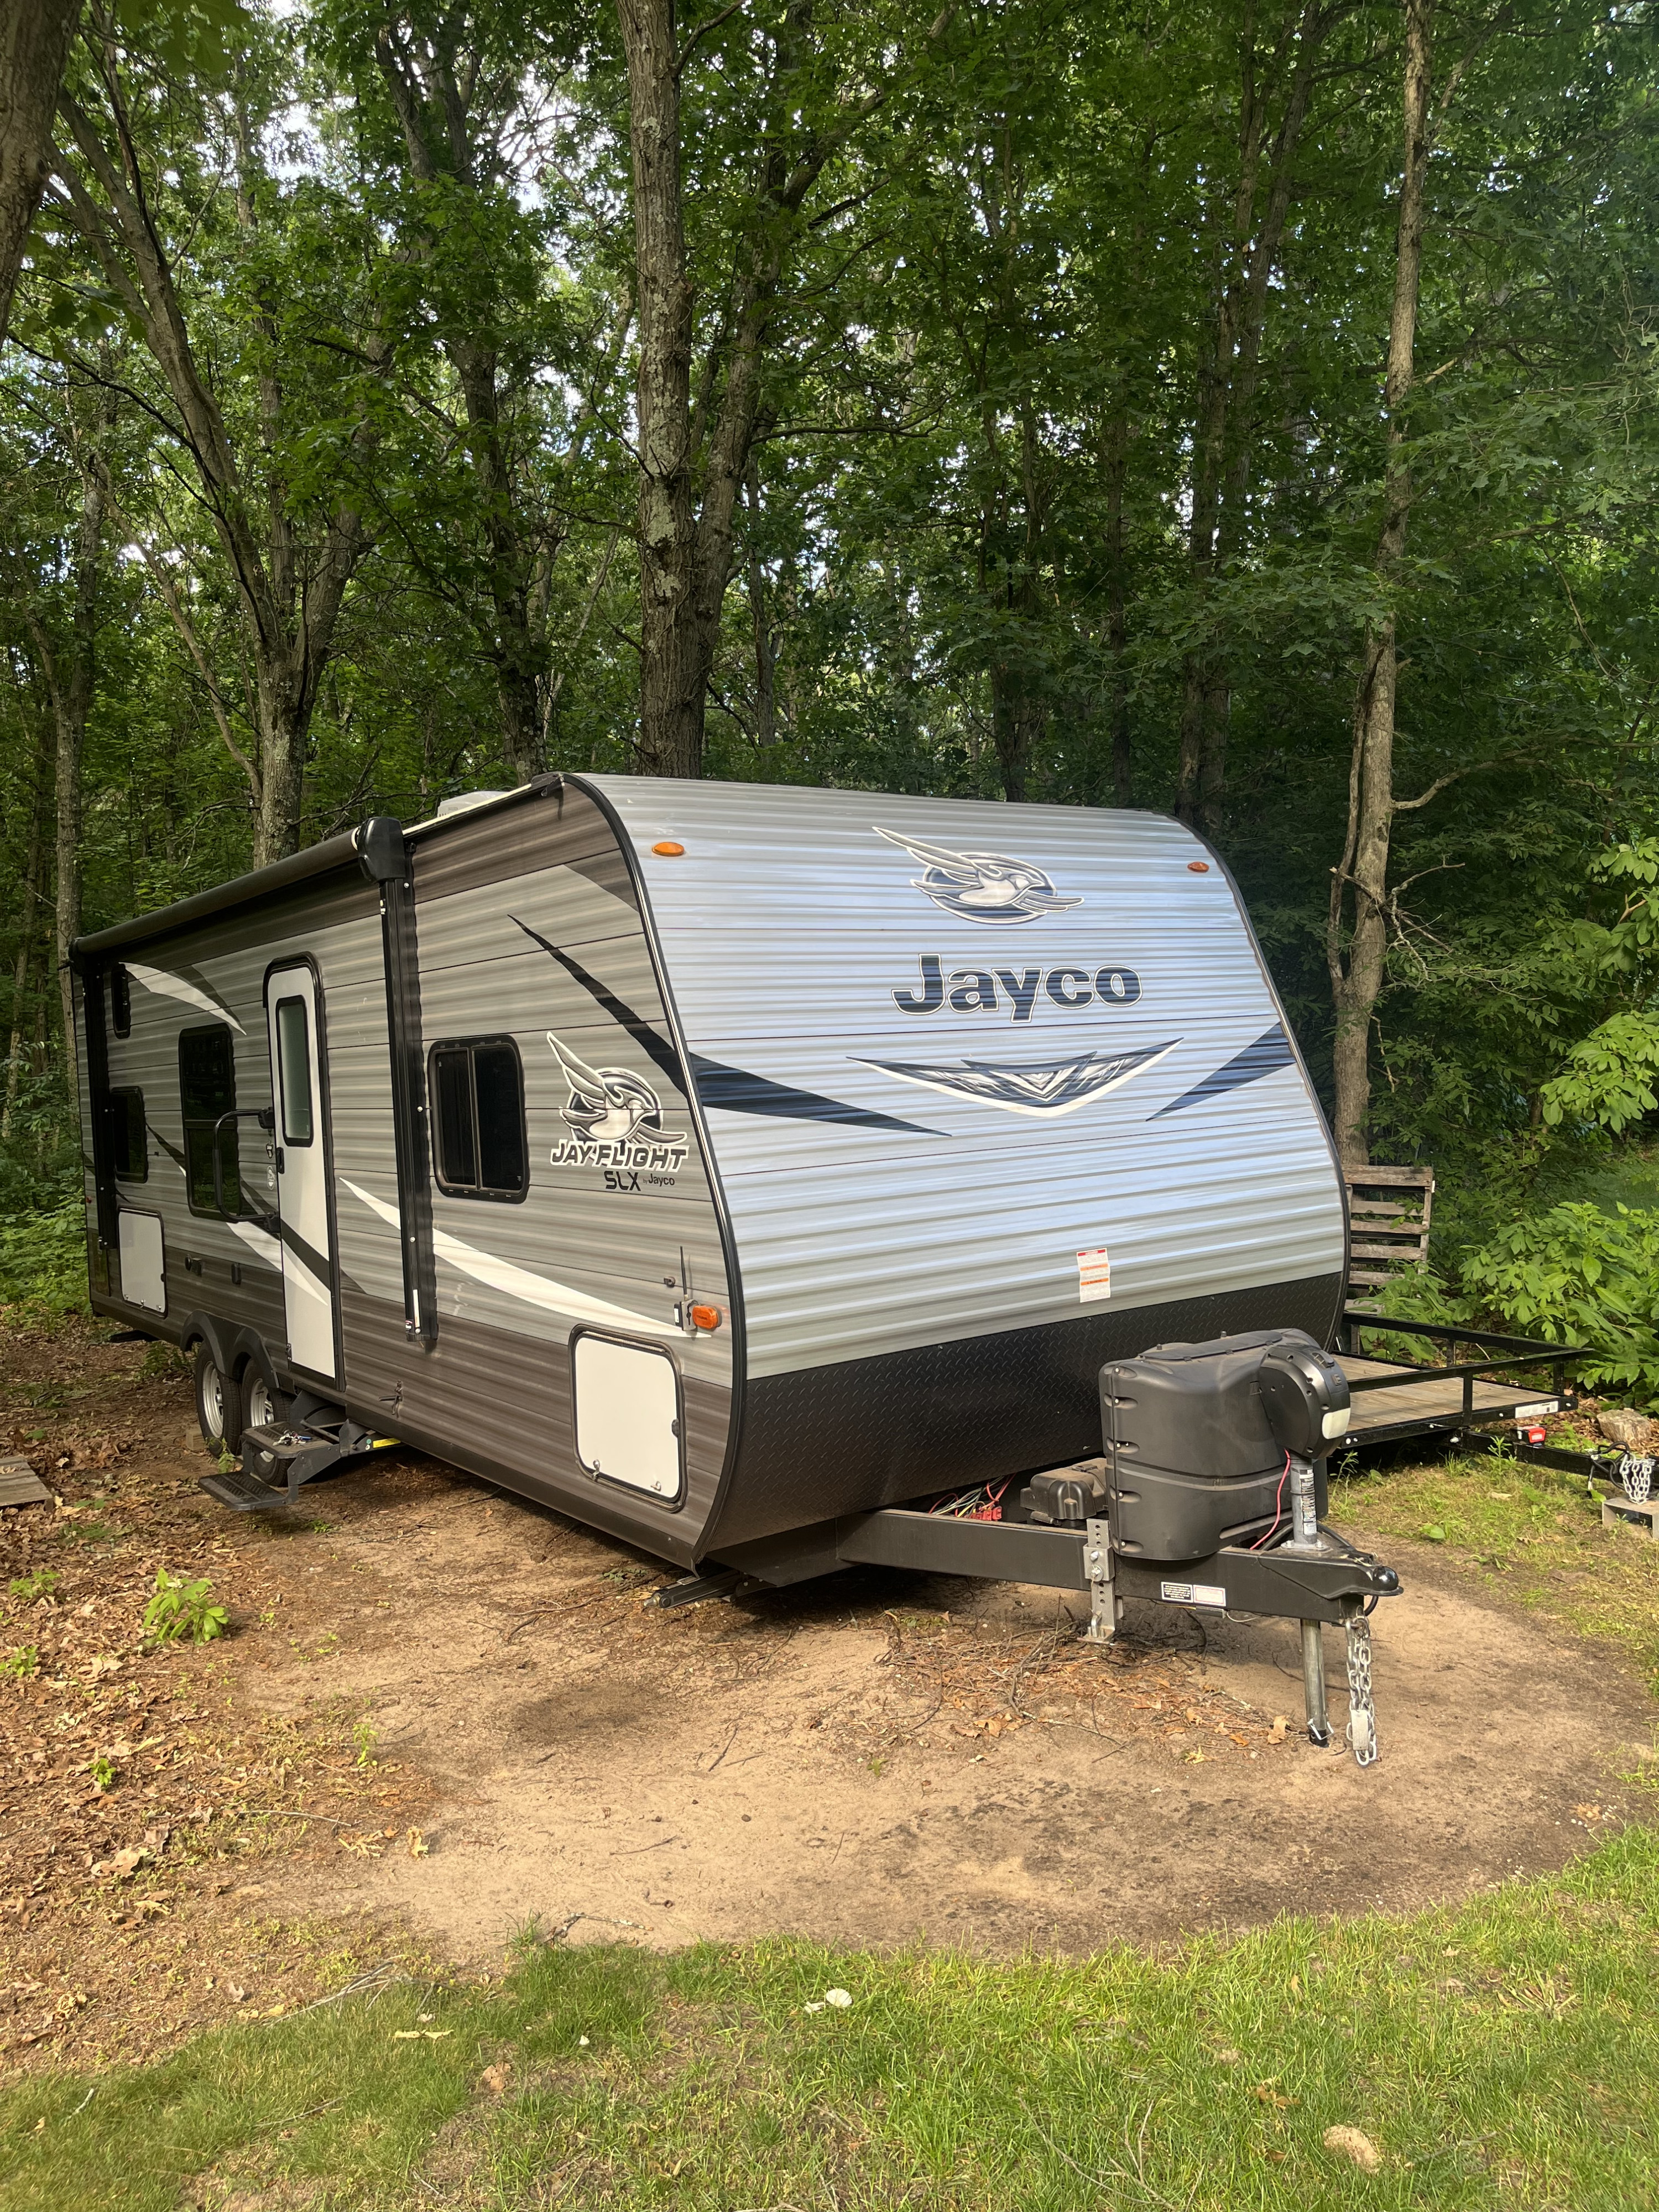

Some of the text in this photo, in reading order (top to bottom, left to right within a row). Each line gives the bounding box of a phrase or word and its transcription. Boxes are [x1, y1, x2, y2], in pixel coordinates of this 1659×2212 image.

[891, 953, 1142, 1022] Jayco
[550, 1139, 689, 1172] JAY FLIGHT
[604, 1171, 641, 1192] SLX
[648, 1173, 675, 1187] Jayco
